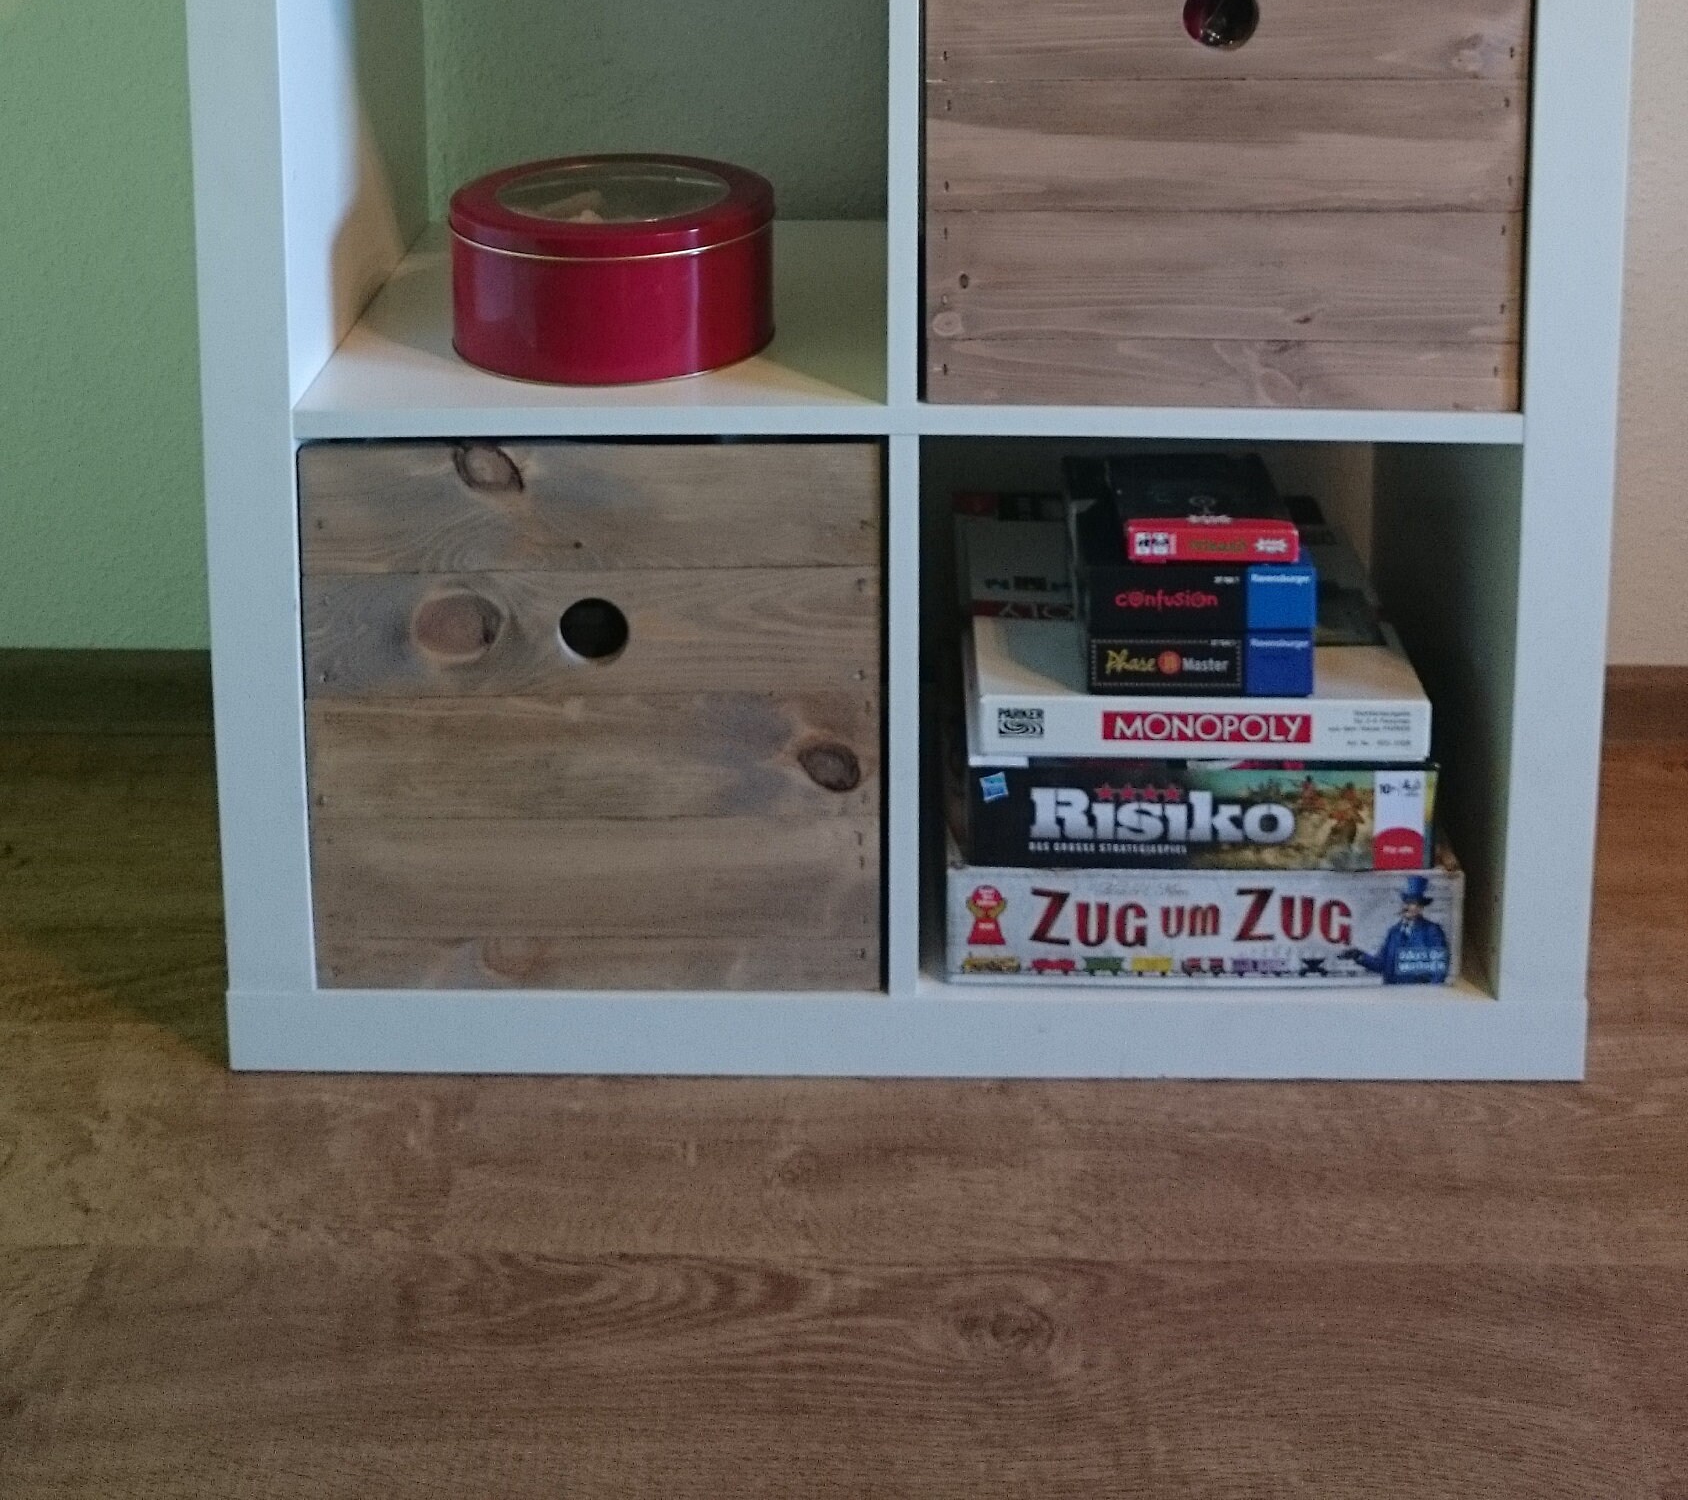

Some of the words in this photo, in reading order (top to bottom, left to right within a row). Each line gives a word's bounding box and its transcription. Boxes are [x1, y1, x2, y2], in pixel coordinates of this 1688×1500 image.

[1105, 649, 1156, 675] Phase
[1182, 657, 1229, 672] Master
[1113, 712, 1302, 742] MONOPOLY
